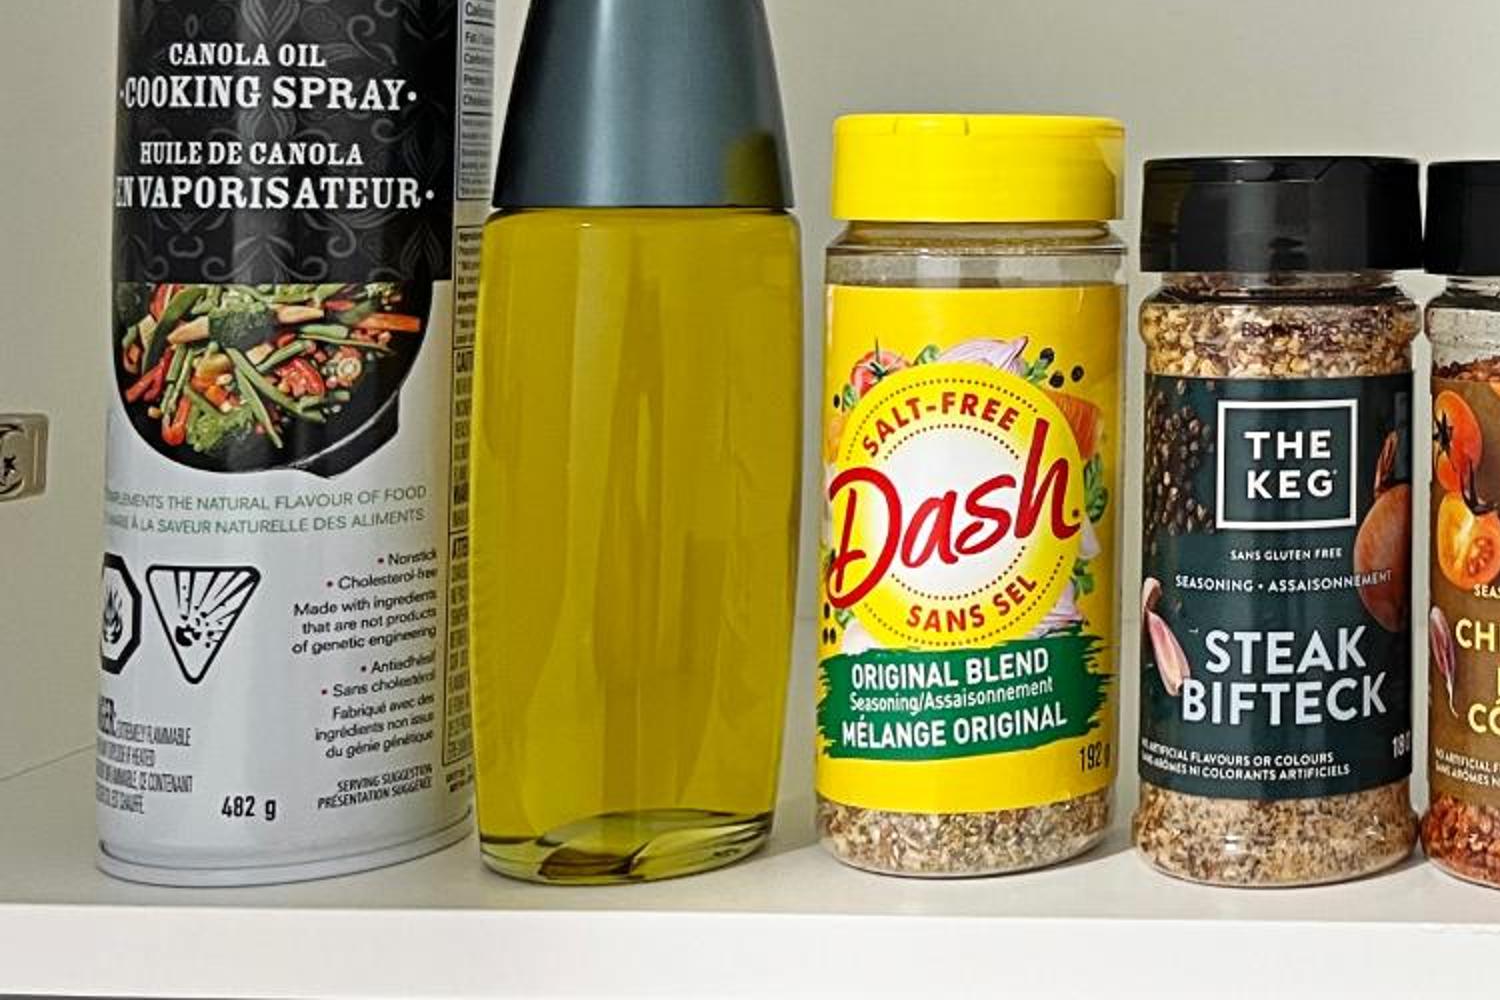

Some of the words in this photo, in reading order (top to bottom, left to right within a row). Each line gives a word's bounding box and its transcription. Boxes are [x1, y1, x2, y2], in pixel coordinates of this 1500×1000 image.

[169, 43, 271, 67] CANOLA
[278, 43, 326, 68] OIL
[125, 75, 262, 109] COOKING
[272, 76, 406, 111] SPRAY
[140, 141, 202, 165] HUILE
[207, 141, 243, 165] DE
[249, 142, 365, 166] CANOLA
[137, 175, 421, 210] VAPORISATEUR
[863, 391, 1020, 458] SALT-FREE
[1244, 430, 1332, 460] THE
[168, 496, 193, 511] THE
[196, 495, 271, 511] NATURAL
[275, 491, 353, 510] FLAVOUR
[357, 489, 380, 505] OF
[384, 484, 427, 502] FOOD
[1246, 469, 1334, 500] KEG
[157, 518, 214, 534] SAVEUR
[215, 517, 310, 534] NATURELLE
[313, 515, 347, 531] DES
[351, 508, 427, 529] ALIMENTS
[826, 416, 1082, 610] Dash
[1229, 549, 1261, 561] SANS
[1263, 548, 1311, 561] GLUTEN
[1315, 547, 1343, 559] FREE
[1175, 574, 1254, 593] SEASONING
[1267, 569, 1393, 593] ASSAISONNEMENT
[293, 602, 338, 617] Made
[341, 598, 370, 612] with
[906, 603, 986, 633] SANS
[991, 574, 1037, 617] SEL
[302, 621, 330, 635] that
[334, 621, 357, 632] are
[361, 616, 383, 629] not
[386, 607, 437, 627] products
[291, 640, 309, 655] of
[311, 637, 365, 655] genetic
[1204, 624, 1368, 676] STEAK
[851, 660, 958, 691] ORIGINAL
[965, 647, 1050, 684] BLEND
[332, 683, 369, 698] Sans
[849, 676, 1053, 717] Seasoning/Assaisonnement
[1181, 670, 1388, 727] BIFTECK
[332, 701, 387, 721] Fabriqué
[389, 698, 415, 713] avec
[387, 717, 409, 731] non
[841, 714, 948, 749] MÉLANGE
[953, 701, 1068, 745] ORIGINAL
[325, 744, 343, 759] du
[346, 739, 381, 759] génie
[1190, 750, 1251, 768] FLAVOURS
[1252, 754, 1272, 768] OR
[1273, 751, 1335, 768] COLOURS
[336, 774, 381, 793] SERVING
[1201, 766, 1277, 782] COLORANTS
[1278, 763, 1351, 782] ARTIFICIELS
[220, 794, 256, 818] 482
[264, 798, 278, 822] g
